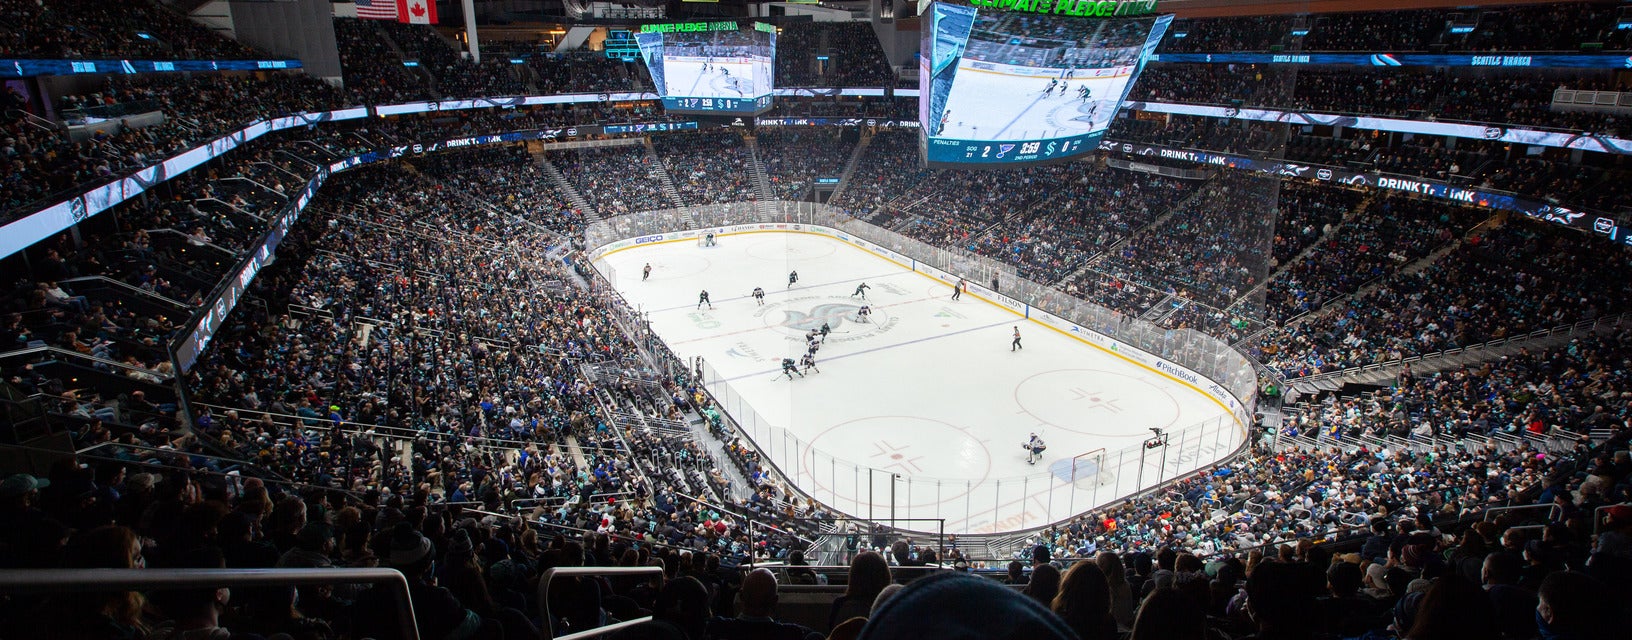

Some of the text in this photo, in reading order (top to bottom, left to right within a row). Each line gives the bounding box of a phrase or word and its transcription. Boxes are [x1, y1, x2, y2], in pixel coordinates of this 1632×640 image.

[1054, 0, 1117, 16] PLEDGE
[675, 22, 707, 32] PLEDGE
[708, 21, 738, 31] ARENA
[1471, 55, 1532, 66] SEATTLE KRAKEN
[899, 120, 921, 128] DRINK
[446, 137, 470, 148] DRINK
[1019, 142, 1041, 154] 3:59
[1061, 141, 1070, 153] 0
[981, 145, 991, 158] 2
[1160, 149, 1187, 161] DRINK
[1378, 177, 1421, 193] DRINK
[1450, 188, 1475, 202] INK
[635, 234, 663, 245] GEICO
[997, 295, 1022, 309] FILSON
[1080, 328, 1104, 342] SYMETRA
[1162, 363, 1198, 385] PitchBook
[1209, 384, 1227, 399] Alaska
